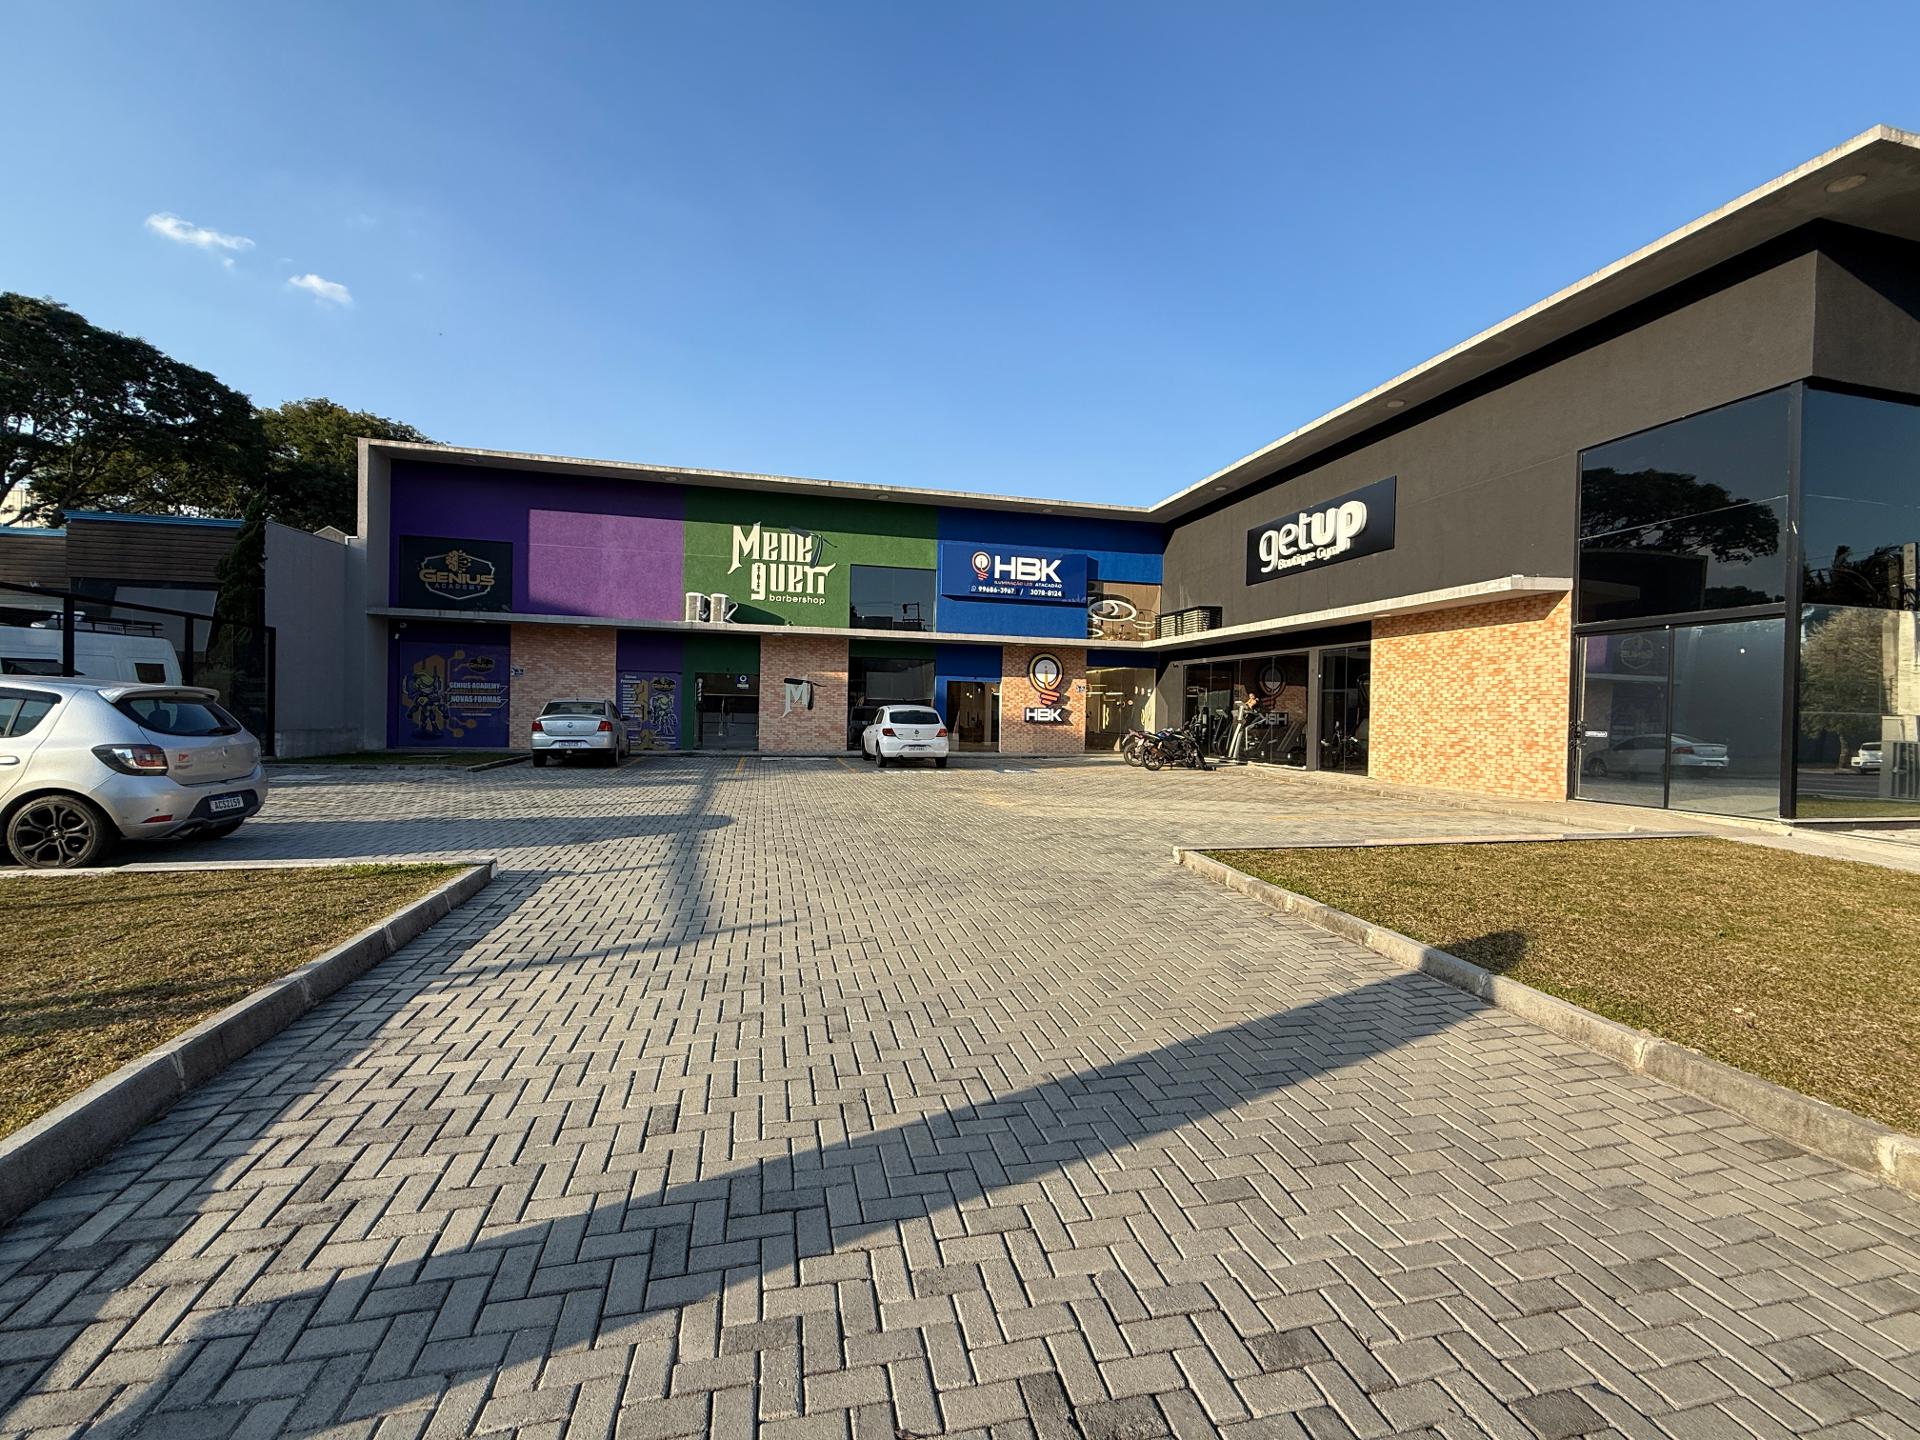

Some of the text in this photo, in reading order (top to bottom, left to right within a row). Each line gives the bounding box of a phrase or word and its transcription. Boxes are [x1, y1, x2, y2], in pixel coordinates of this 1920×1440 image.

[1259, 500, 1367, 573] getup
[727, 521, 813, 575] Mene
[994, 555, 1062, 582] HBK
[1277, 551, 1316, 570] Boutique
[434, 583, 482, 592] ACADEMY
[769, 594, 826, 606] barbershop
[1026, 708, 1063, 722] HBK
